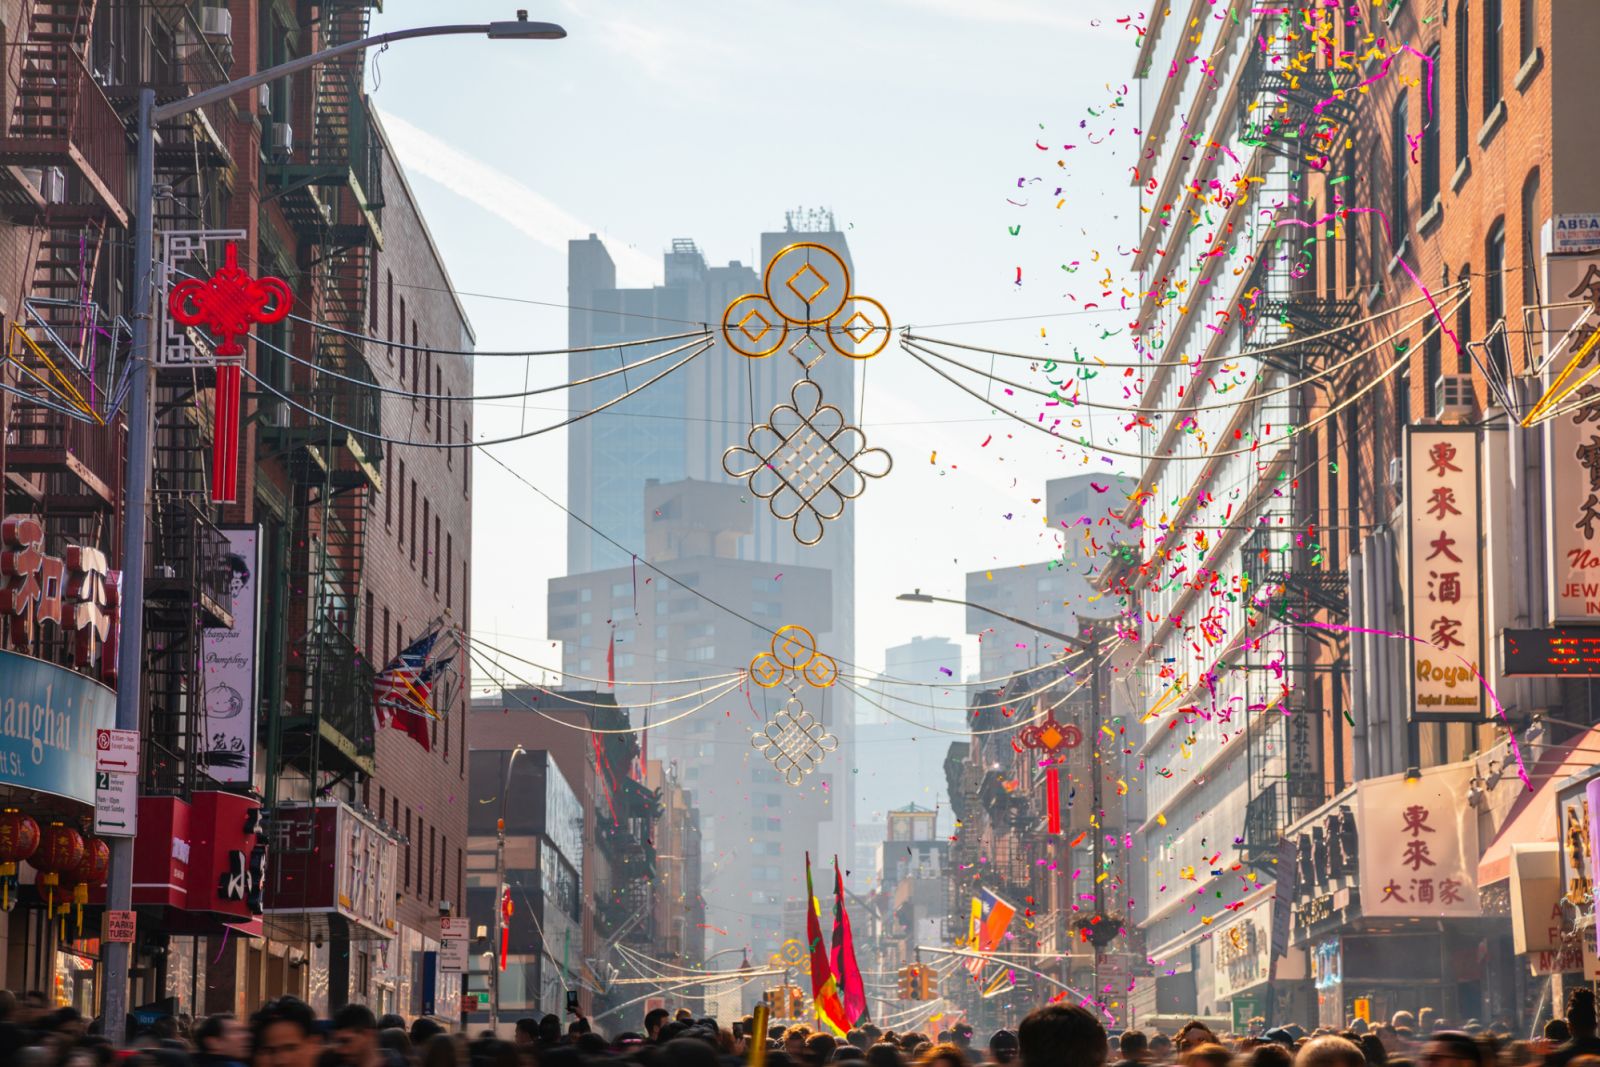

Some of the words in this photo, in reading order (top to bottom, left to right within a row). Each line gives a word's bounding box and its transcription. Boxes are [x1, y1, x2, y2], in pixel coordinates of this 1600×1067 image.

[1425, 441, 1466, 652] 東來大酒家
[205, 651, 249, 669] Dumpling
[1416, 659, 1478, 689] Royal
[0, 683, 72, 766] anghai
[99, 772, 107, 788] 2
[1380, 878, 1465, 905] 大酒家
